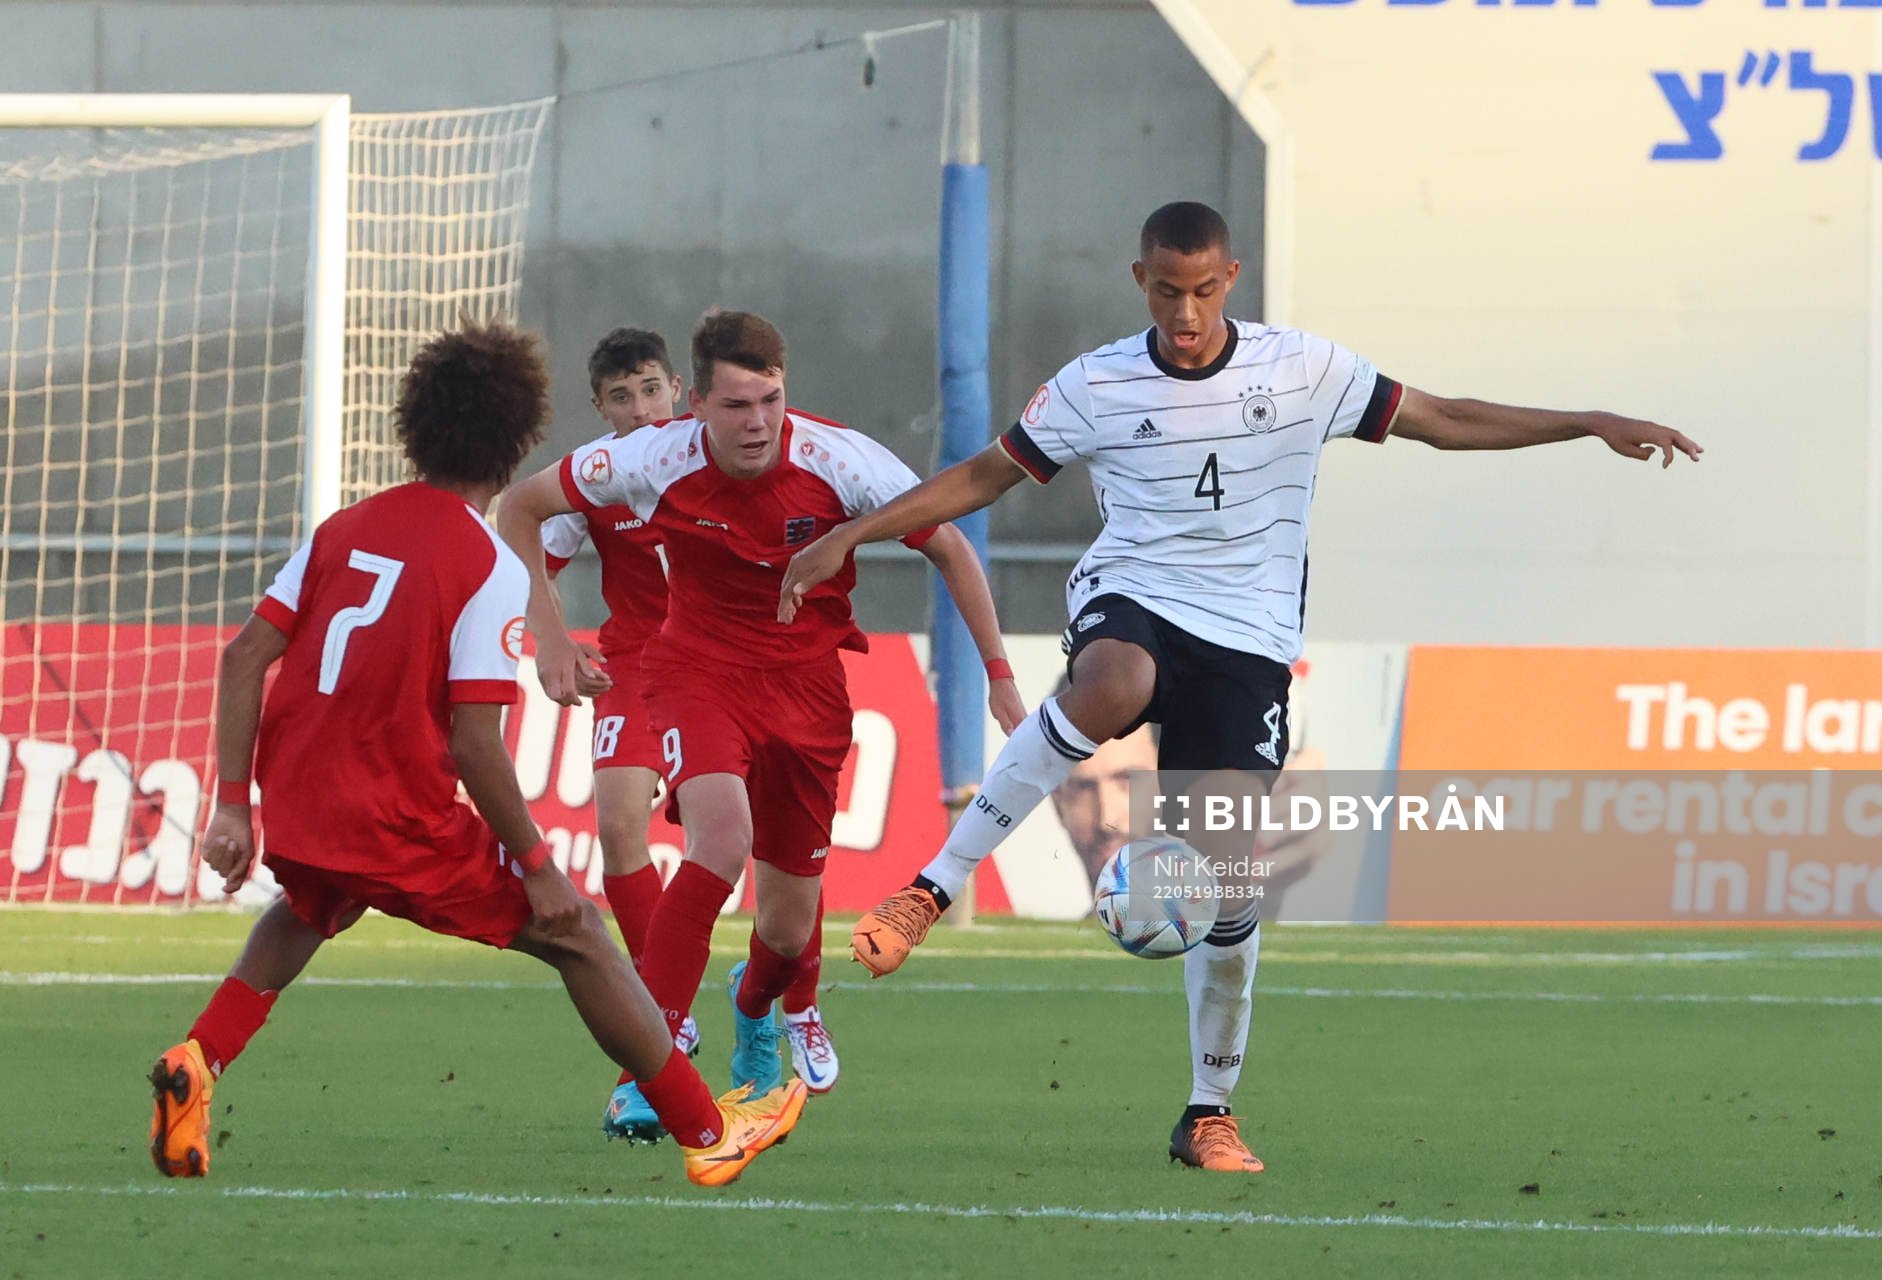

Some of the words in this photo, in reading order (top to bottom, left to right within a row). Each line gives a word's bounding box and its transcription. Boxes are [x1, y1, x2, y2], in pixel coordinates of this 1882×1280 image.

[1194, 452, 1225, 511] 4
[614, 519, 643, 531] JAKO
[318, 549, 405, 695] 7
[1263, 701, 1281, 745] 4
[1616, 682, 1769, 751] The
[662, 727, 683, 783] 9
[976, 795, 1012, 827] DFB
[1581, 768, 1832, 836] rental
[1671, 840, 1750, 913] in
[1203, 1053, 1241, 1068] DFB
